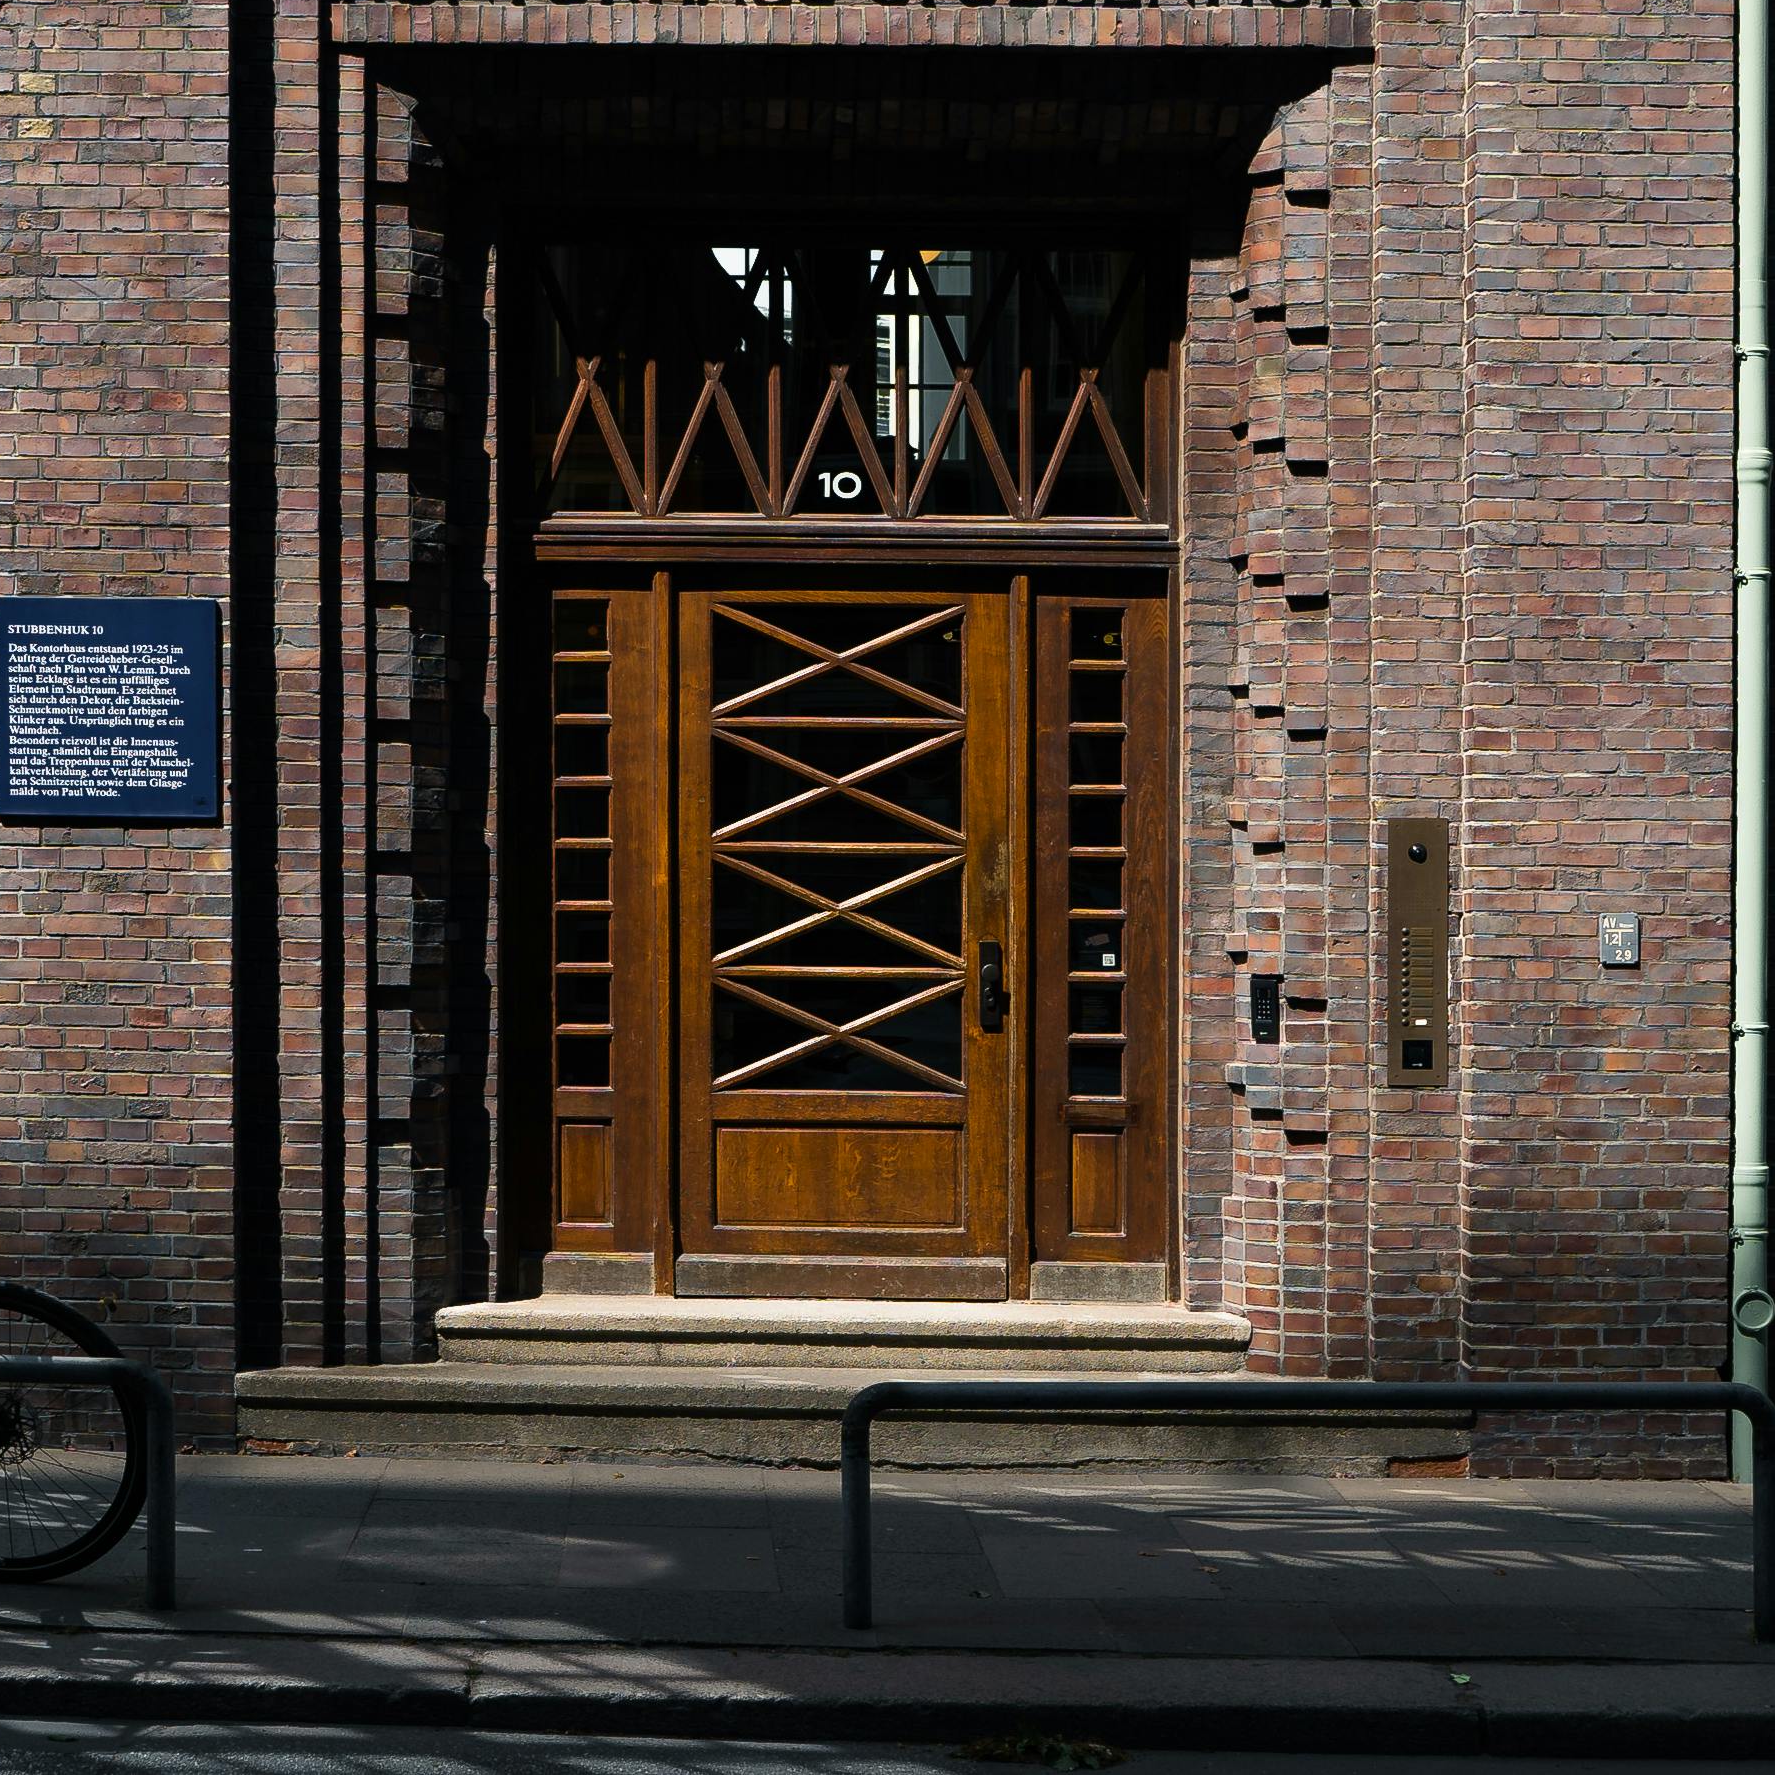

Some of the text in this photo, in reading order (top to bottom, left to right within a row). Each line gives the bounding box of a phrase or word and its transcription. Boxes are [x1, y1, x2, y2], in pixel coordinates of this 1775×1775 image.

[818, 471, 862, 499] 10
[8, 626, 104, 635] STUBBENHUK 10
[9, 644, 184, 655] Das Kontorhaus entstand 1923-25 im
[8, 654, 48, 665] Auftrag
[48, 655, 66, 664] der
[8, 665, 37, 673] schaft
[39, 665, 62, 674] nach
[64, 665, 86, 674] Plan
[108, 666, 121, 675] W.
[159, 667, 191, 675] Durch
[8, 675, 34, 684] seine
[35, 675, 74, 686] Ecklage
[76, 676, 88, 685] ist
[101, 676, 118, 685] ein
[9, 685, 177, 695] Element im Stadtraum. Es zeichnet
[8, 695, 185, 706] sich durch den Dekor, die Backstein-
[9, 706, 169, 718] Schmuckmotive und den farbigen
[9, 716, 47, 724] Klinker
[69, 716, 132, 727] Ursprünglich
[134, 717, 155, 728] trug
[169, 717, 185, 726] ein
[9, 726, 62, 735] Walmdach.
[9, 737, 179, 747] Besonders reizvoll ist die Innenaus-
[9, 747, 178, 759] stattung, nämlich die Eingangshalle
[9, 757, 195, 768] und das Treppenhaus mit der Muschel-
[91, 768, 109, 777] der
[111, 768, 168, 779] Vertäfelung
[169, 769, 188, 778] und
[9, 777, 187, 790] den Schnitzereien sowie dem Glasge-
[10, 787, 39, 796] mälde
[61, 788, 83, 797] Paul
[1603, 917, 1616, 929] AV
[1604, 933, 1619, 945] 1,2
[1616, 949, 1632, 962] 2,9
